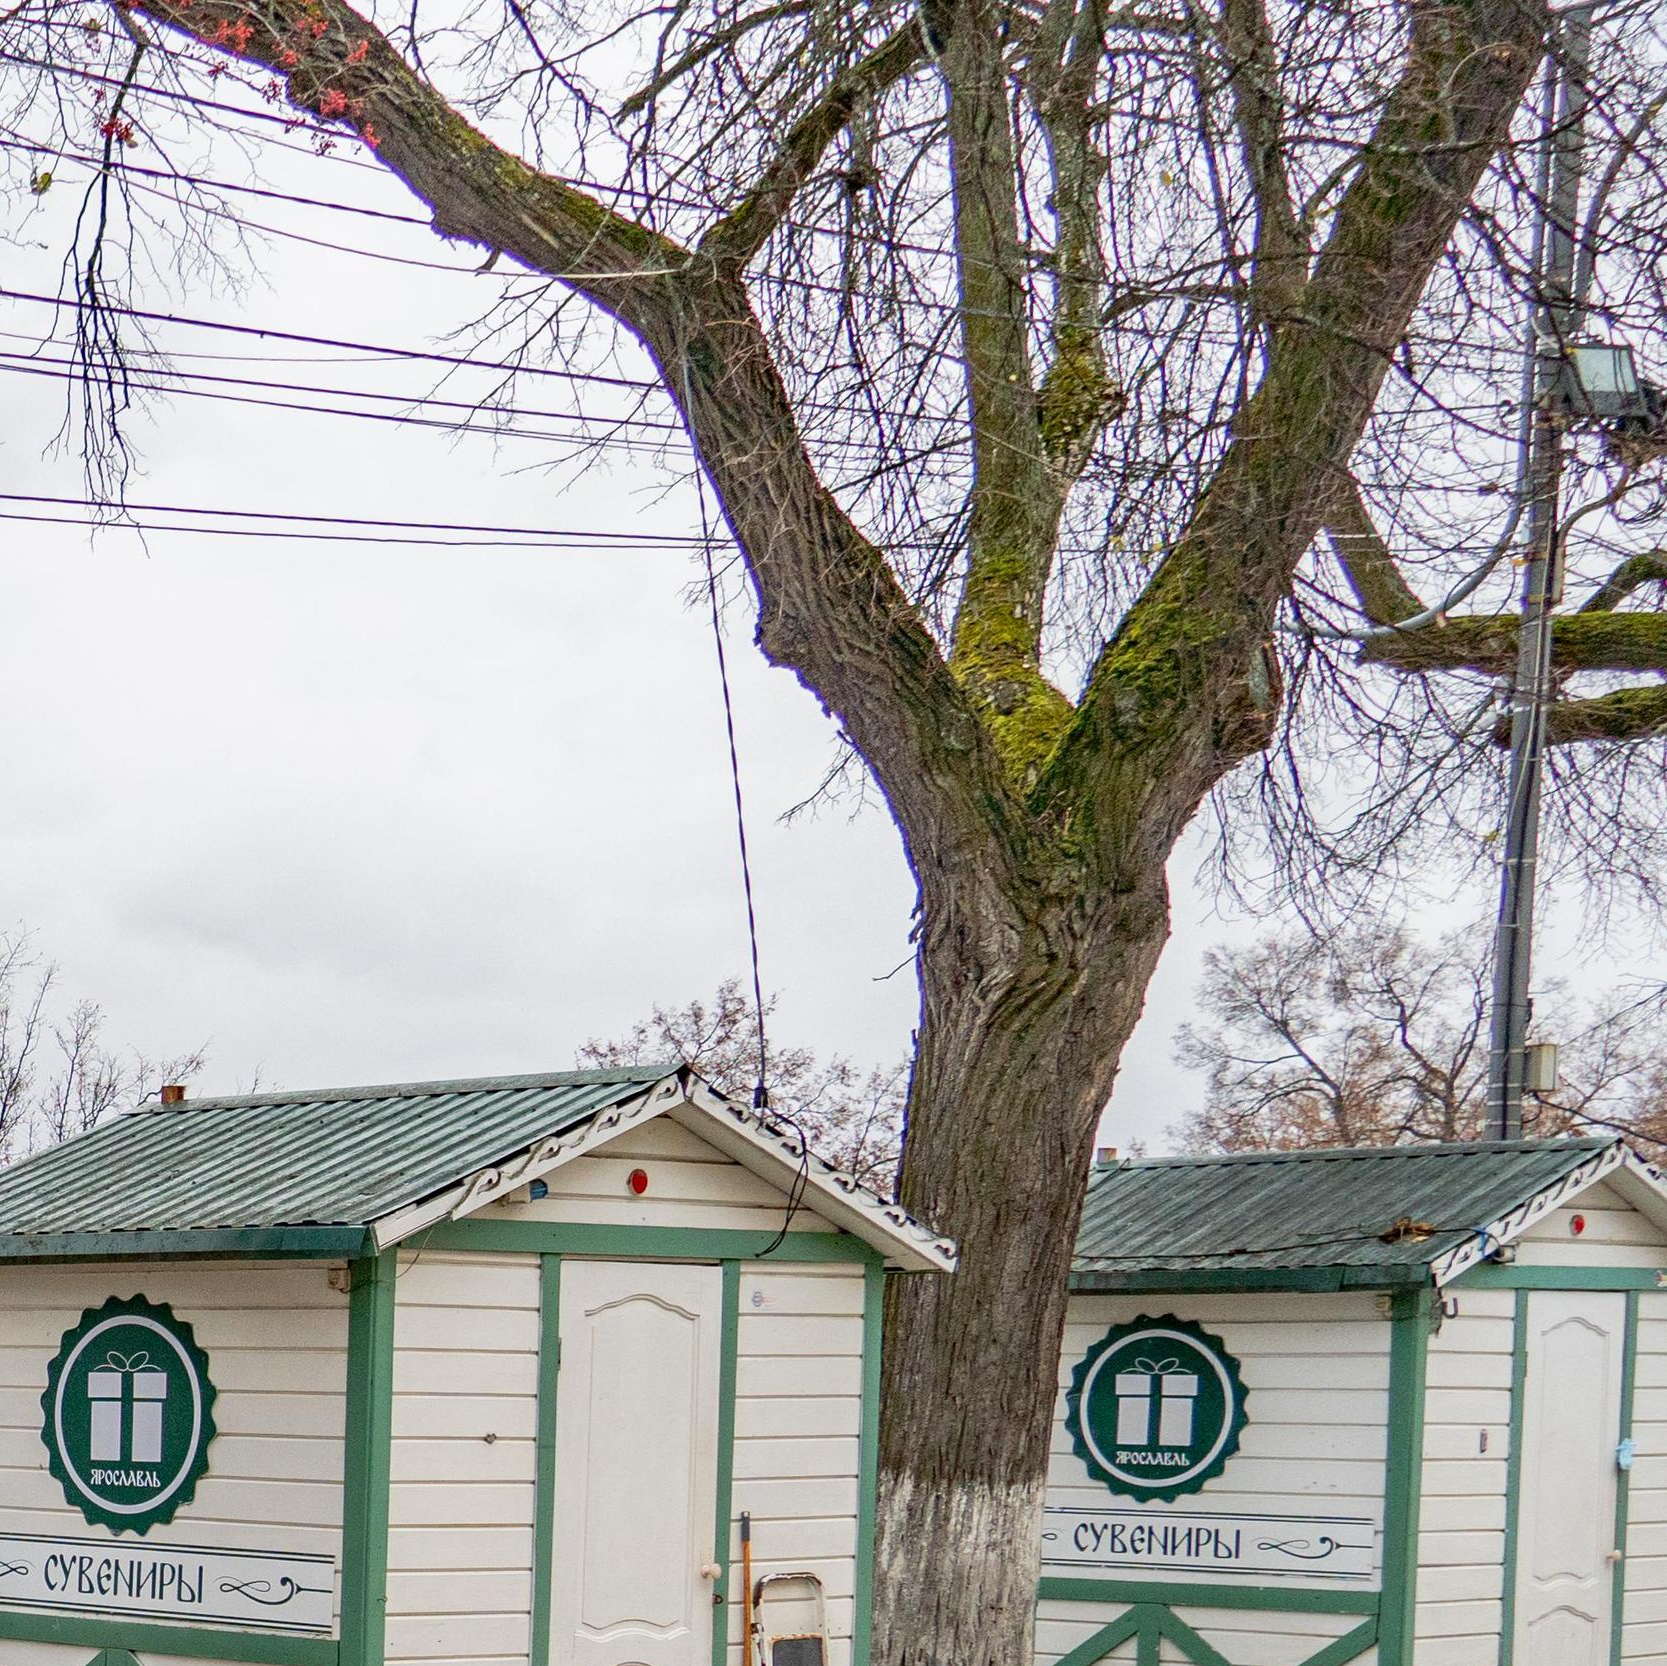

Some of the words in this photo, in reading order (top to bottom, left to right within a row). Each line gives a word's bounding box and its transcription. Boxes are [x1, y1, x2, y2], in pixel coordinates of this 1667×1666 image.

[1115, 1450, 1190, 1467] ЯРОСЛАВЛЬ
[90, 1468, 162, 1488] ЯРОСЛАВЛЬ
[1073, 1522, 1241, 1559] СУВЕНИРЫ
[44, 1553, 204, 1604] СУВЕНИРЫ
